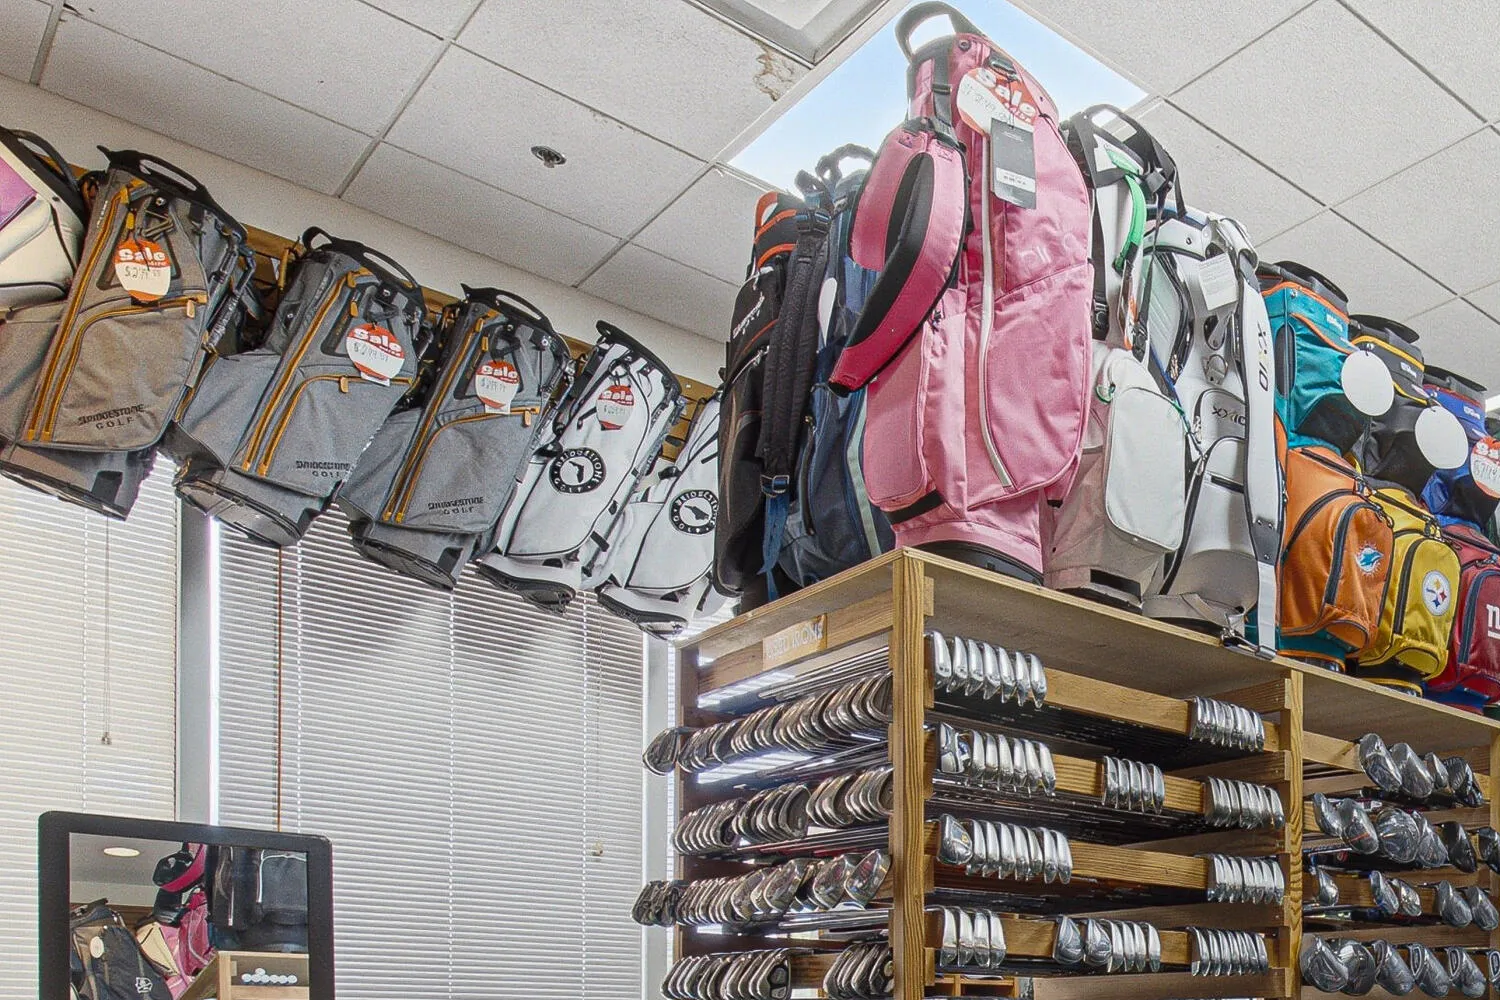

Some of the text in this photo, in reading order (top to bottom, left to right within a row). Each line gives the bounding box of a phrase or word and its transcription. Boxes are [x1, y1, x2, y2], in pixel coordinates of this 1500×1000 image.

[976, 67, 1037, 117] Sale
[118, 246, 166, 262] Sale
[353, 328, 403, 353] Sale
[481, 364, 519, 379] Sale
[601, 389, 635, 402] Sale
[78, 403, 145, 426] BRIDGESTONE
[95, 415, 135, 430] GOLF
[556, 449, 603, 484] BRIDGESTONE
